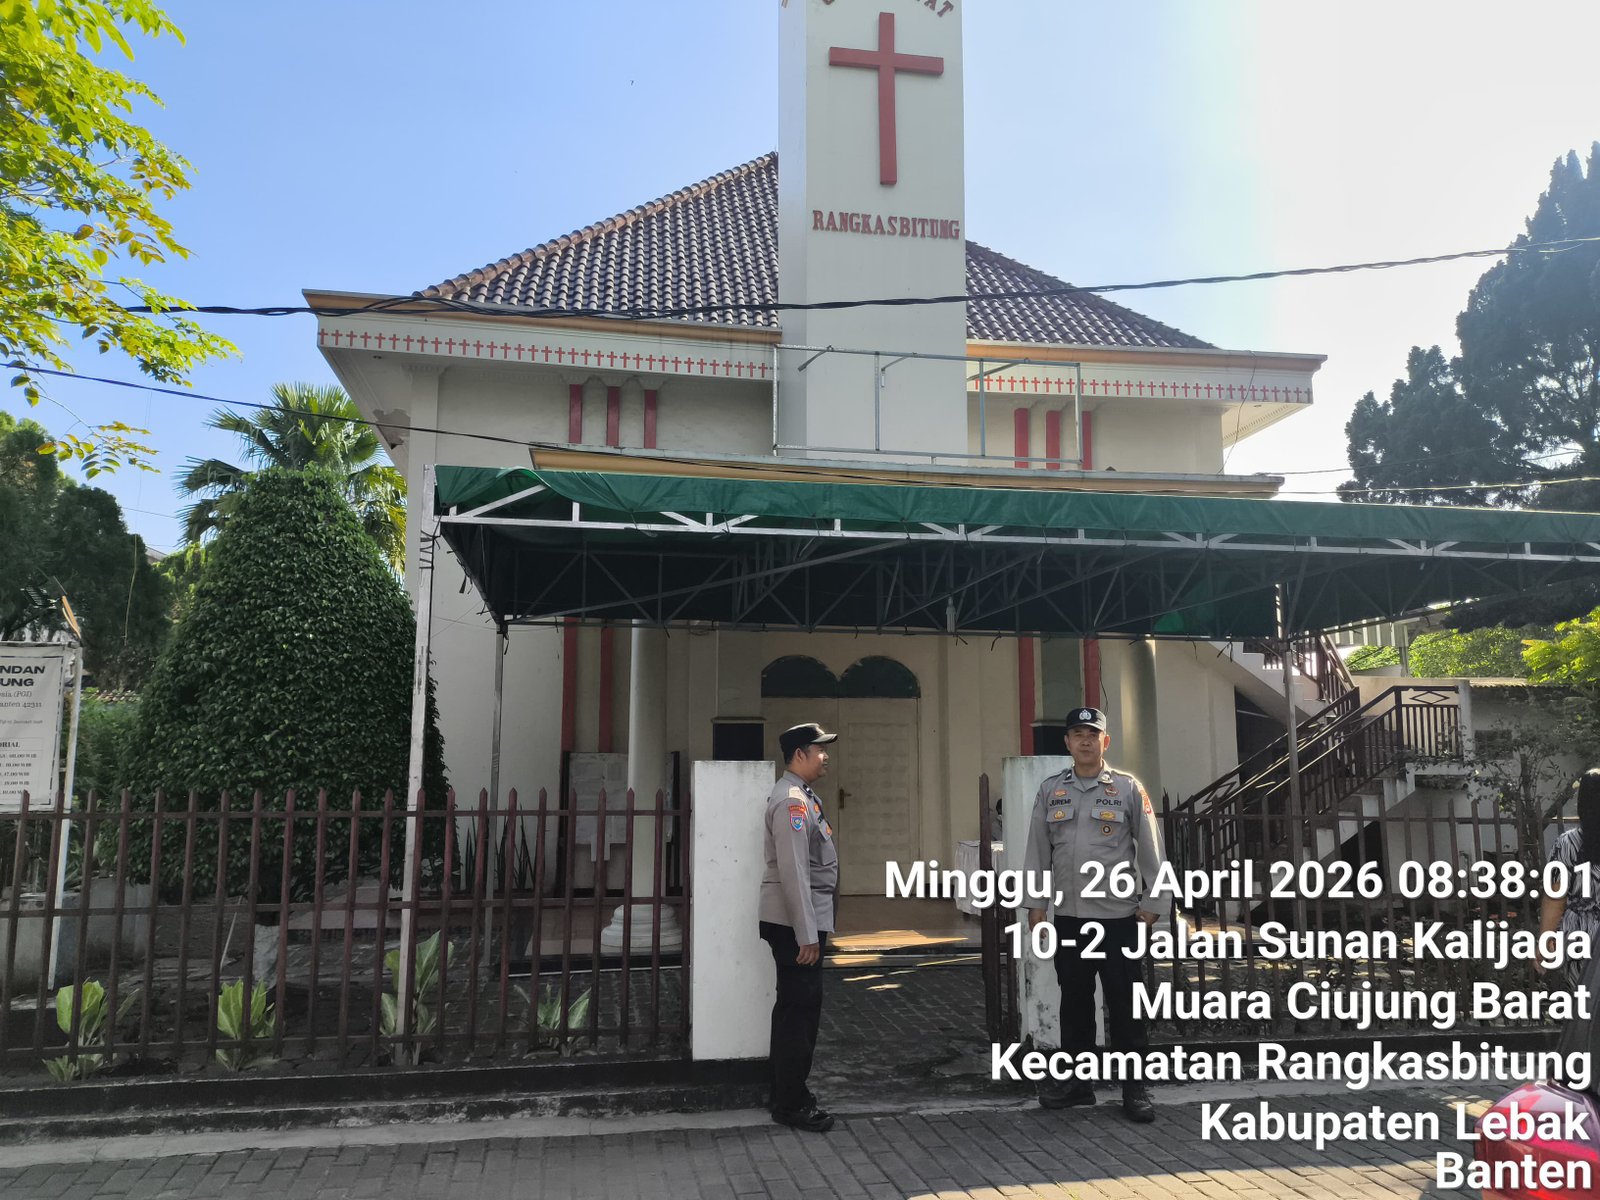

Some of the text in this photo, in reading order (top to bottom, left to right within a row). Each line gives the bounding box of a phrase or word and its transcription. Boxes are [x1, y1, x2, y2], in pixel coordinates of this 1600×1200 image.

[916, 0, 954, 17] AT
[812, 209, 960, 240] RANGKASBITUNG
[0, 665, 46, 674] NDAN
[0, 677, 35, 687] UNG
[1095, 798, 1122, 806] POLRI
